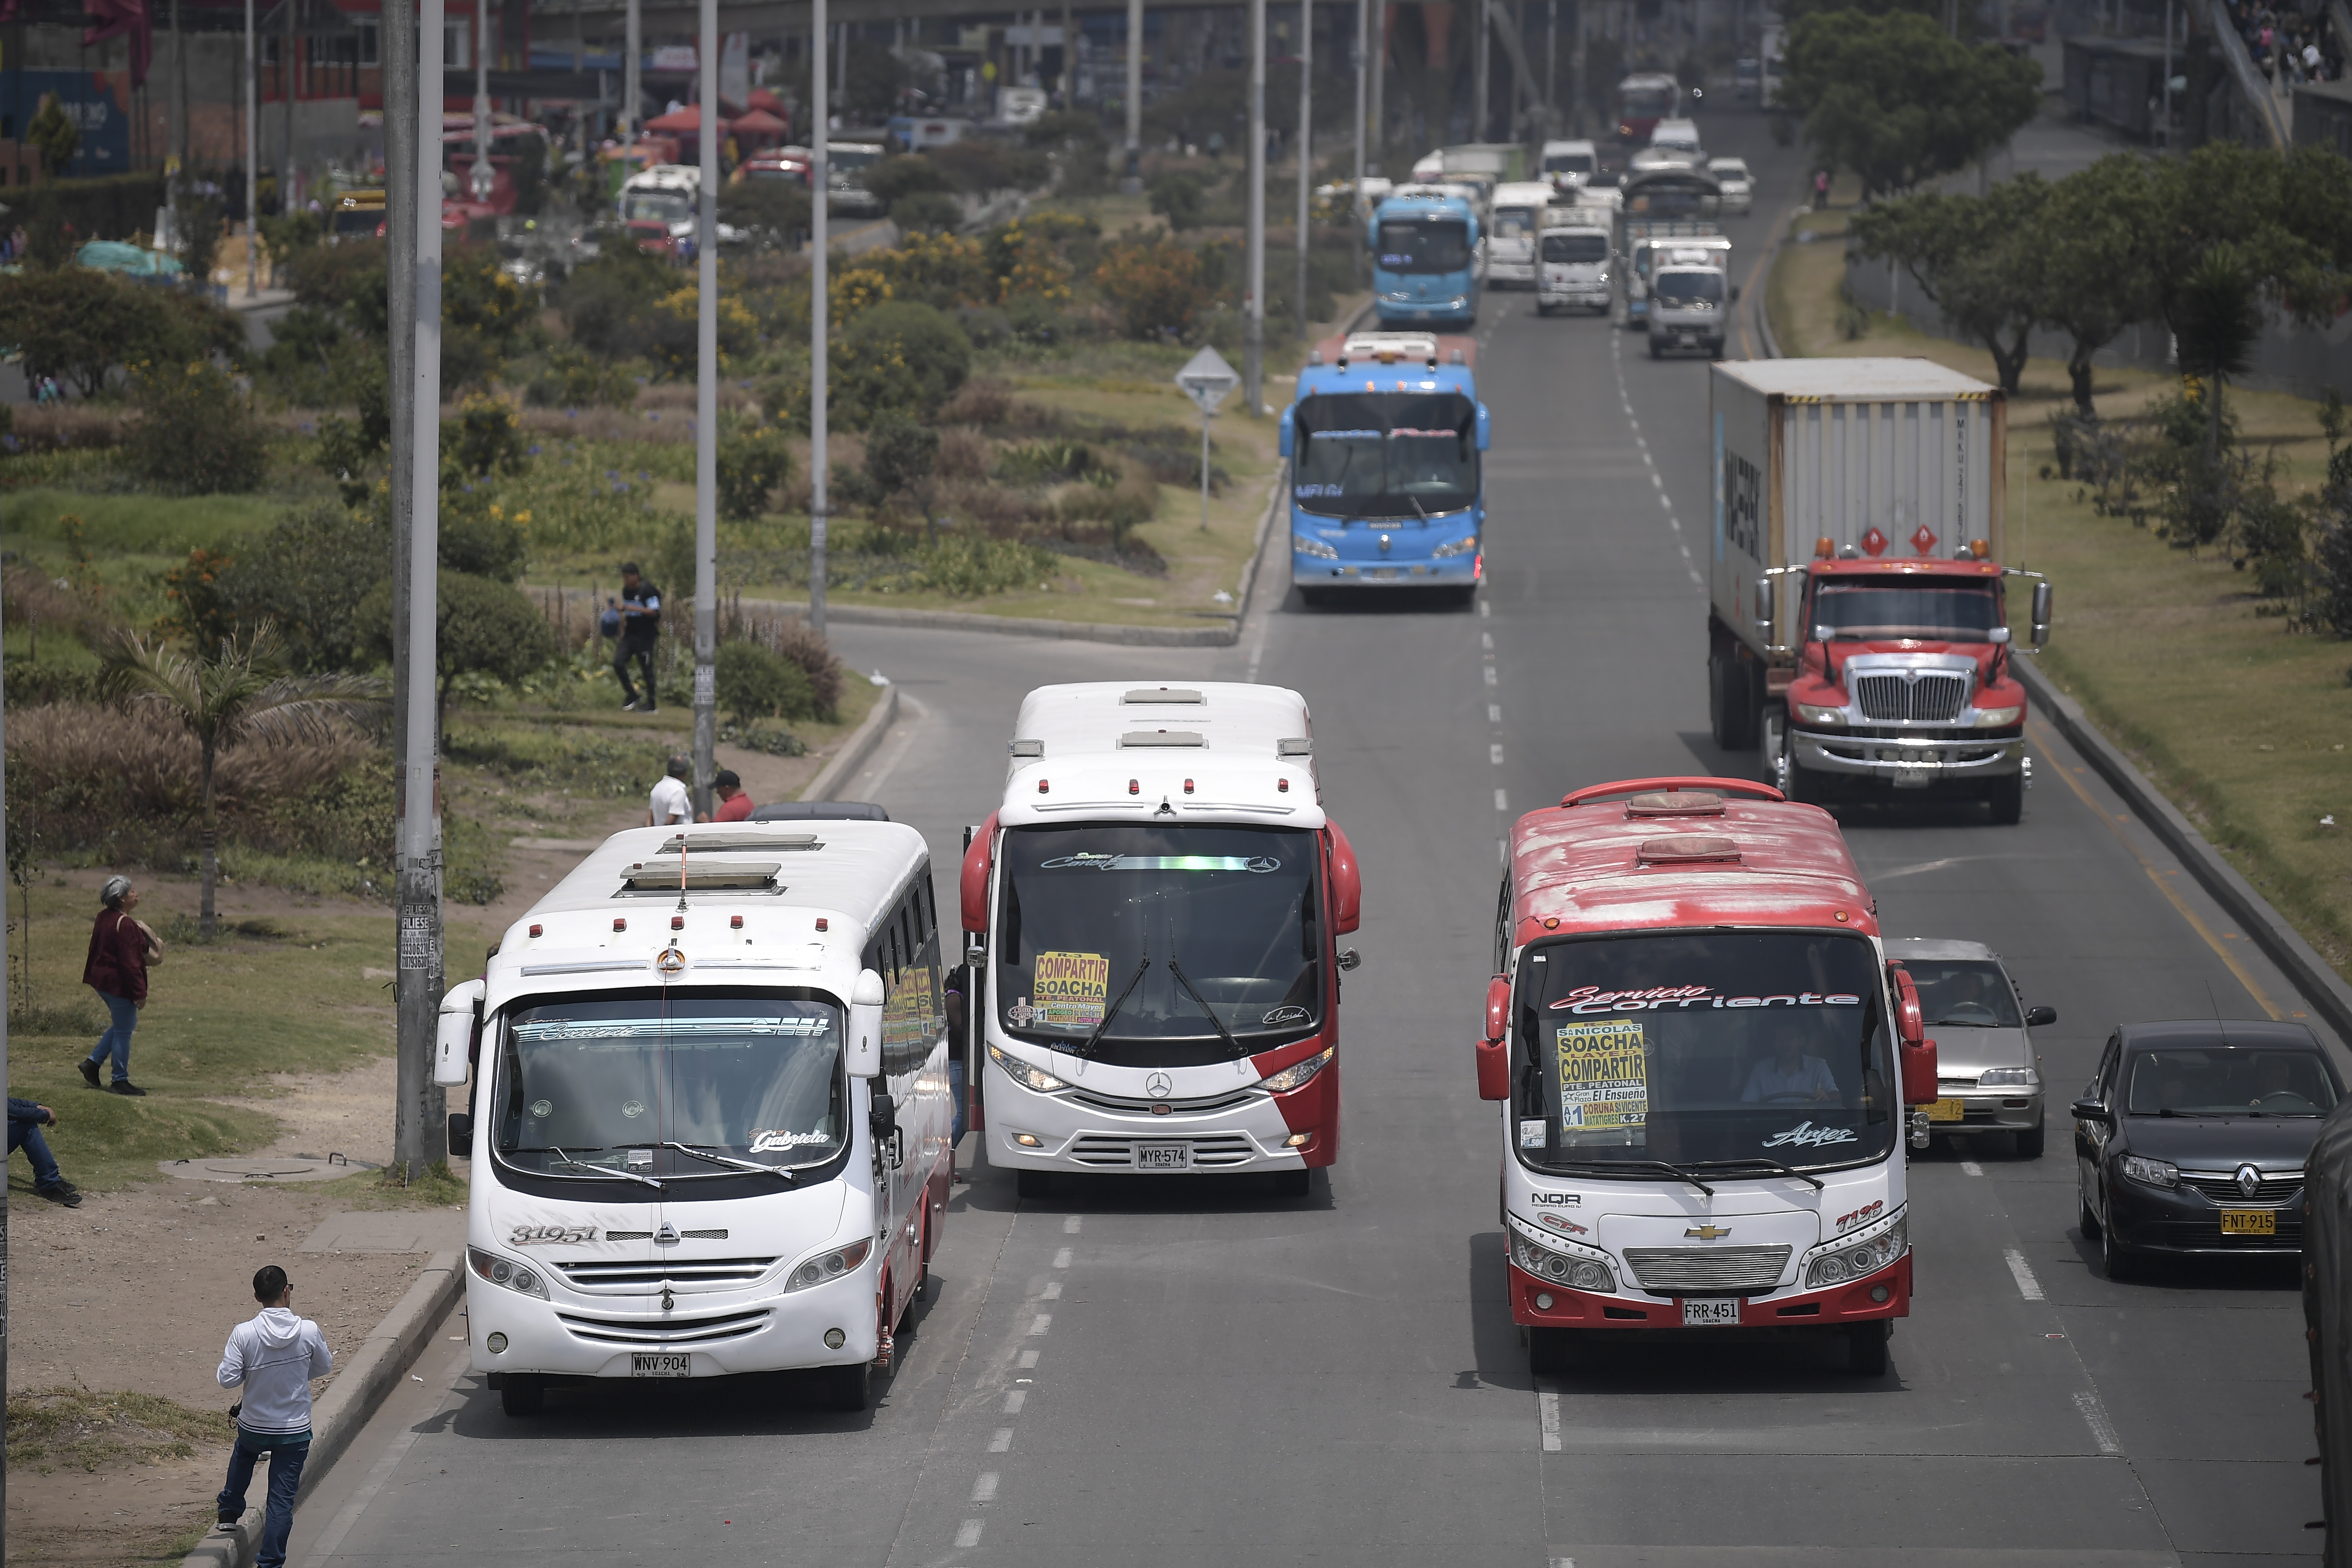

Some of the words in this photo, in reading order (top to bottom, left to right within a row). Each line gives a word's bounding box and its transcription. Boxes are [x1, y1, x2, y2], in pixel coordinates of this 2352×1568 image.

[402, 917, 428, 929] FILIESE
[1037, 957, 1107, 984] COMPARTIR
[1035, 980, 1104, 996] SOACHA
[1548, 985, 1715, 1009] Servicio
[1572, 992, 1859, 1014] Corriente
[1575, 1024, 1641, 1035] NICOLAS
[1560, 1033, 1642, 1054] SOACHA
[1561, 1054, 1644, 1082] COMPARTIR
[1588, 1079, 1642, 1089] PEATONAL
[1592, 1090, 1602, 1101] El
[1605, 1088, 1645, 1101] Ensueño
[1584, 1102, 1614, 1115] CORUÑA
[1621, 1100, 1647, 1113] VICENTE
[1584, 1114, 1618, 1126] MATATIGRES
[1620, 1112, 1646, 1123] K.27
[749, 1129, 830, 1154] Gabriela
[1532, 1193, 1581, 1204] NQR
[1835, 1200, 1883, 1233] 7128
[509, 1226, 597, 1244] 31951
